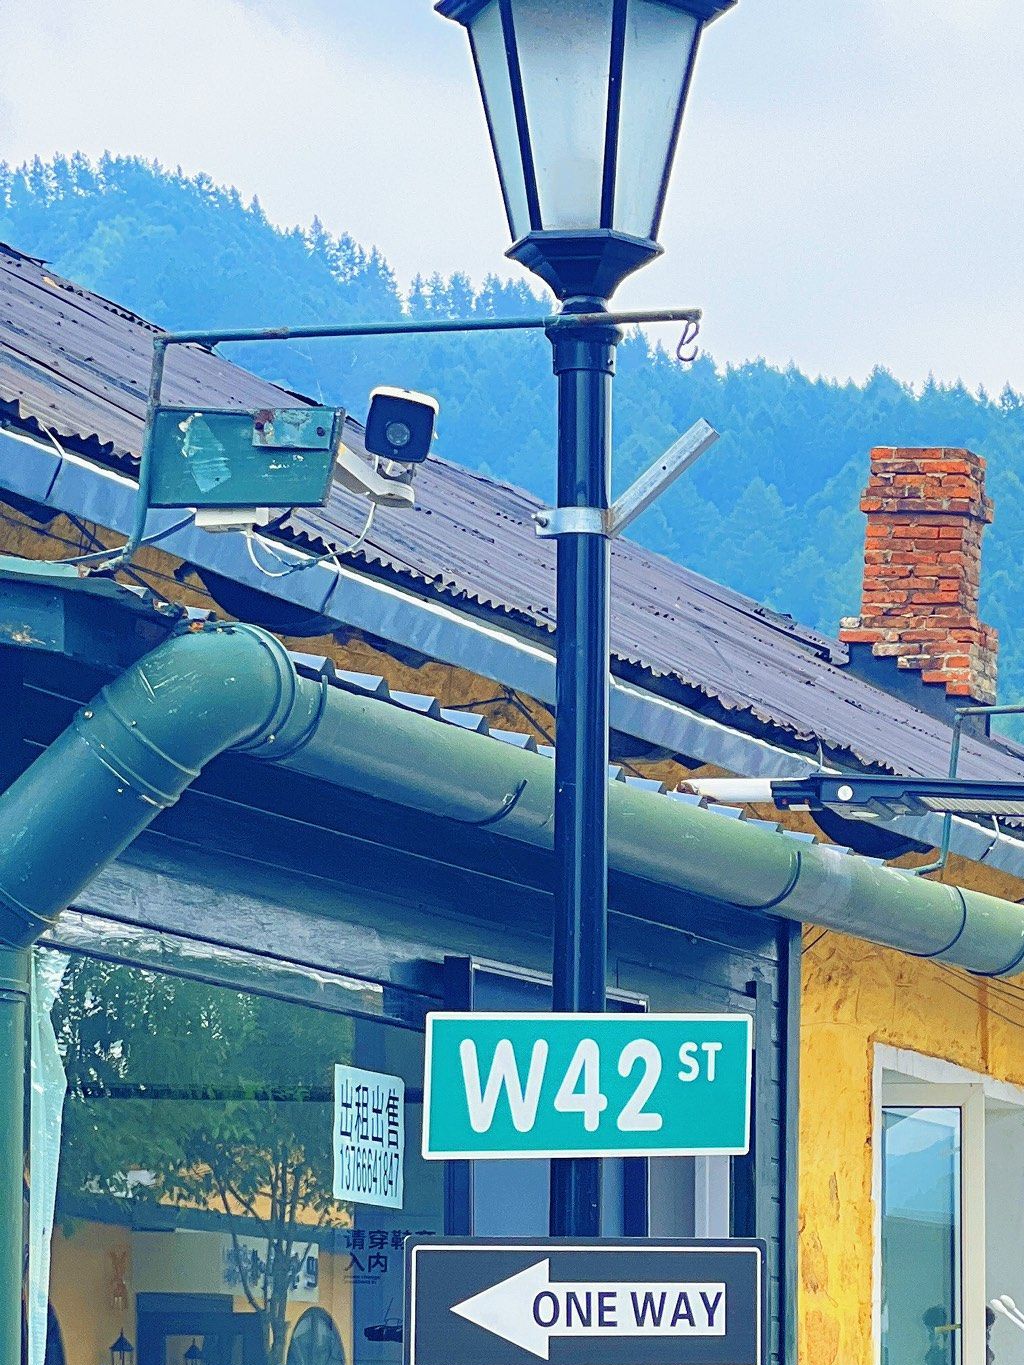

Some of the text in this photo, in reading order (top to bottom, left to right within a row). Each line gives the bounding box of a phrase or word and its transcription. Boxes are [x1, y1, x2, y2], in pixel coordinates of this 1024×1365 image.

[459, 1038, 723, 1134] W42 ST
[339, 1079, 400, 1149] 出租出售
[340, 1144, 399, 1197] 13766641847
[343, 1229, 437, 1250] 请穿鞋
[344, 1252, 388, 1273] 入内
[532, 1290, 724, 1328] ONE WAY
